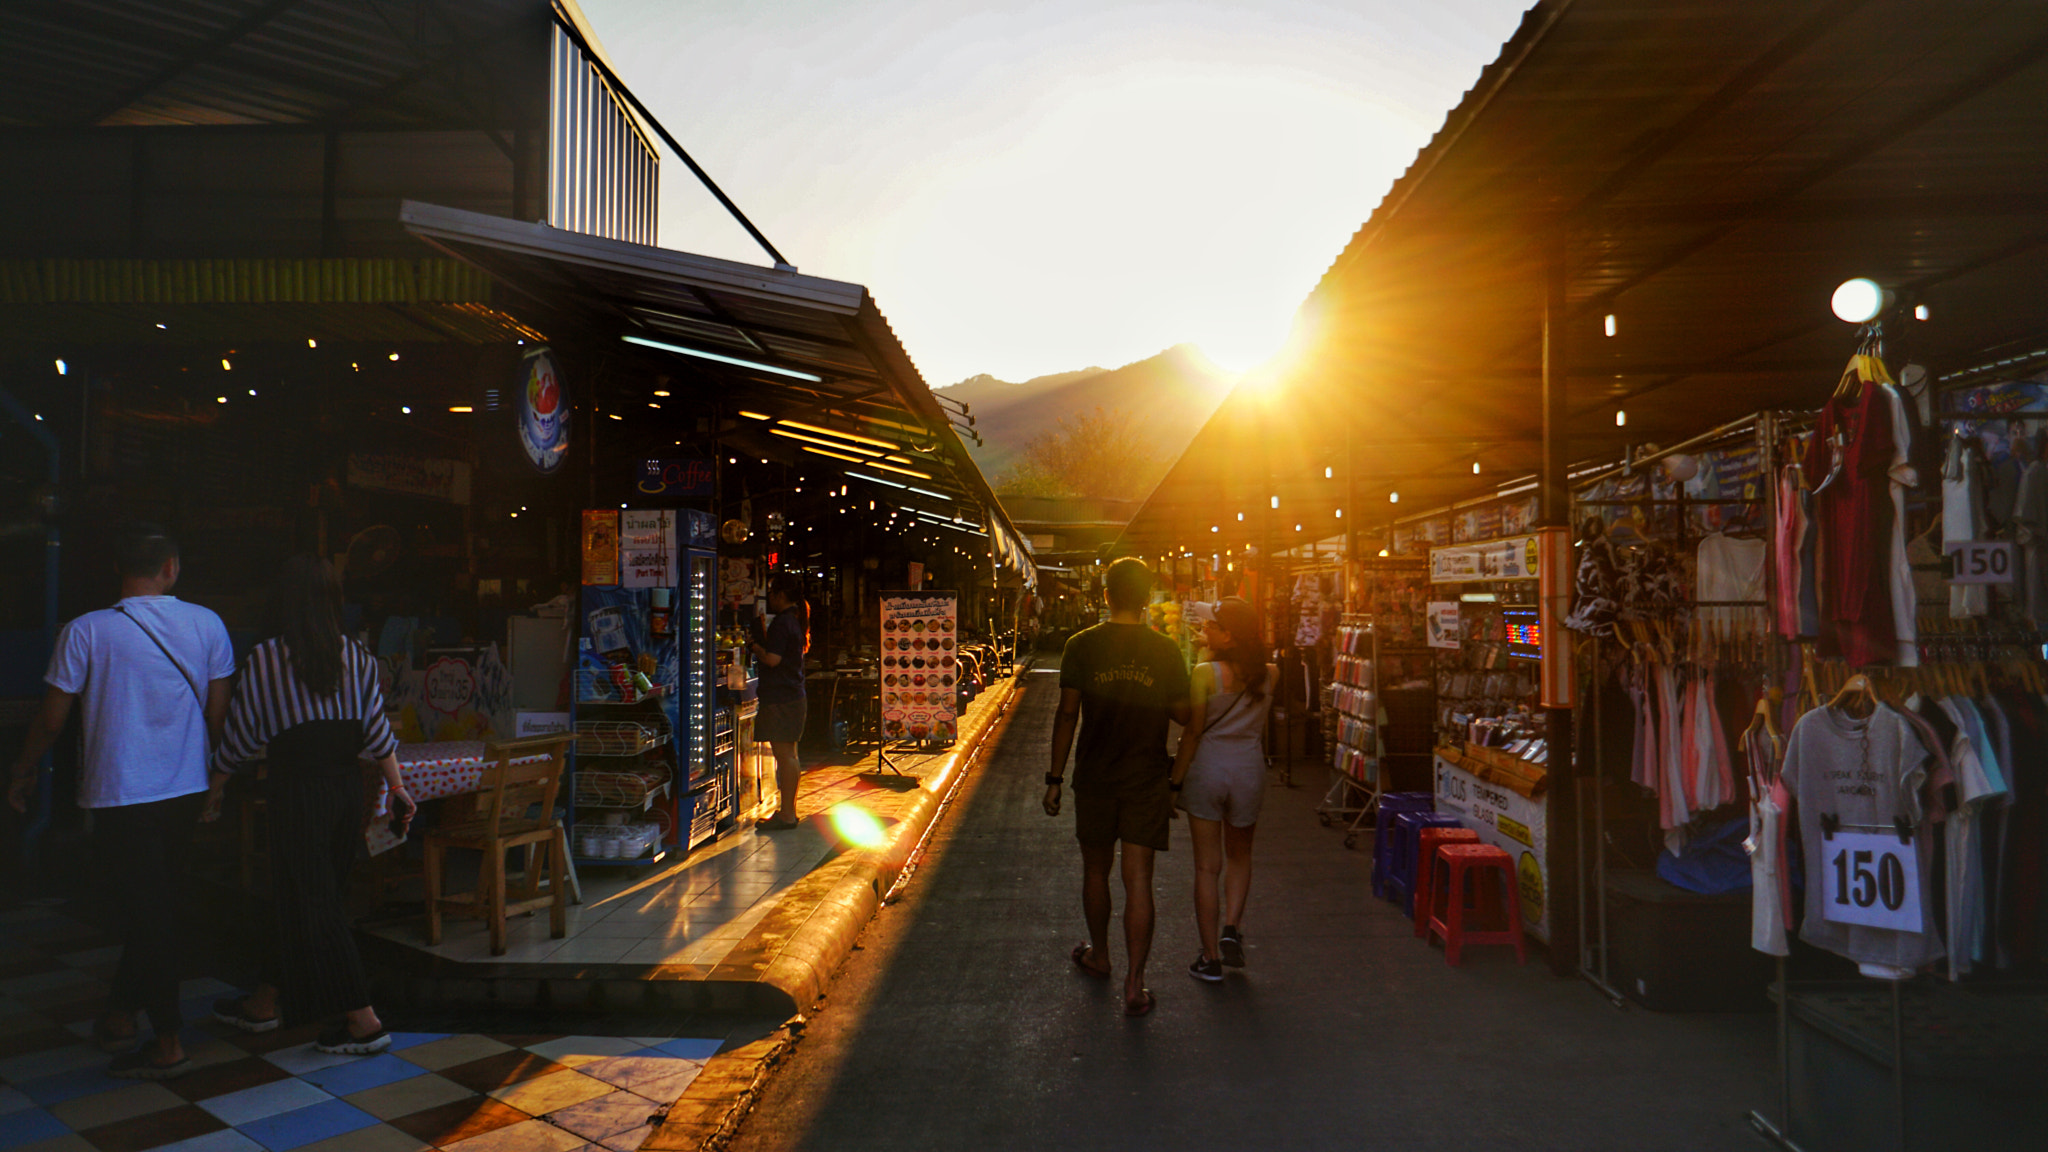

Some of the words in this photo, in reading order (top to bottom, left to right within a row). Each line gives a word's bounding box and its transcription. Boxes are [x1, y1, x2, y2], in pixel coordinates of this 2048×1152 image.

[662, 460, 712, 490] Coffee
[1951, 548, 2008, 575] 150
[1472, 783, 1509, 811] TEMPERED
[1832, 848, 1905, 912] 150
